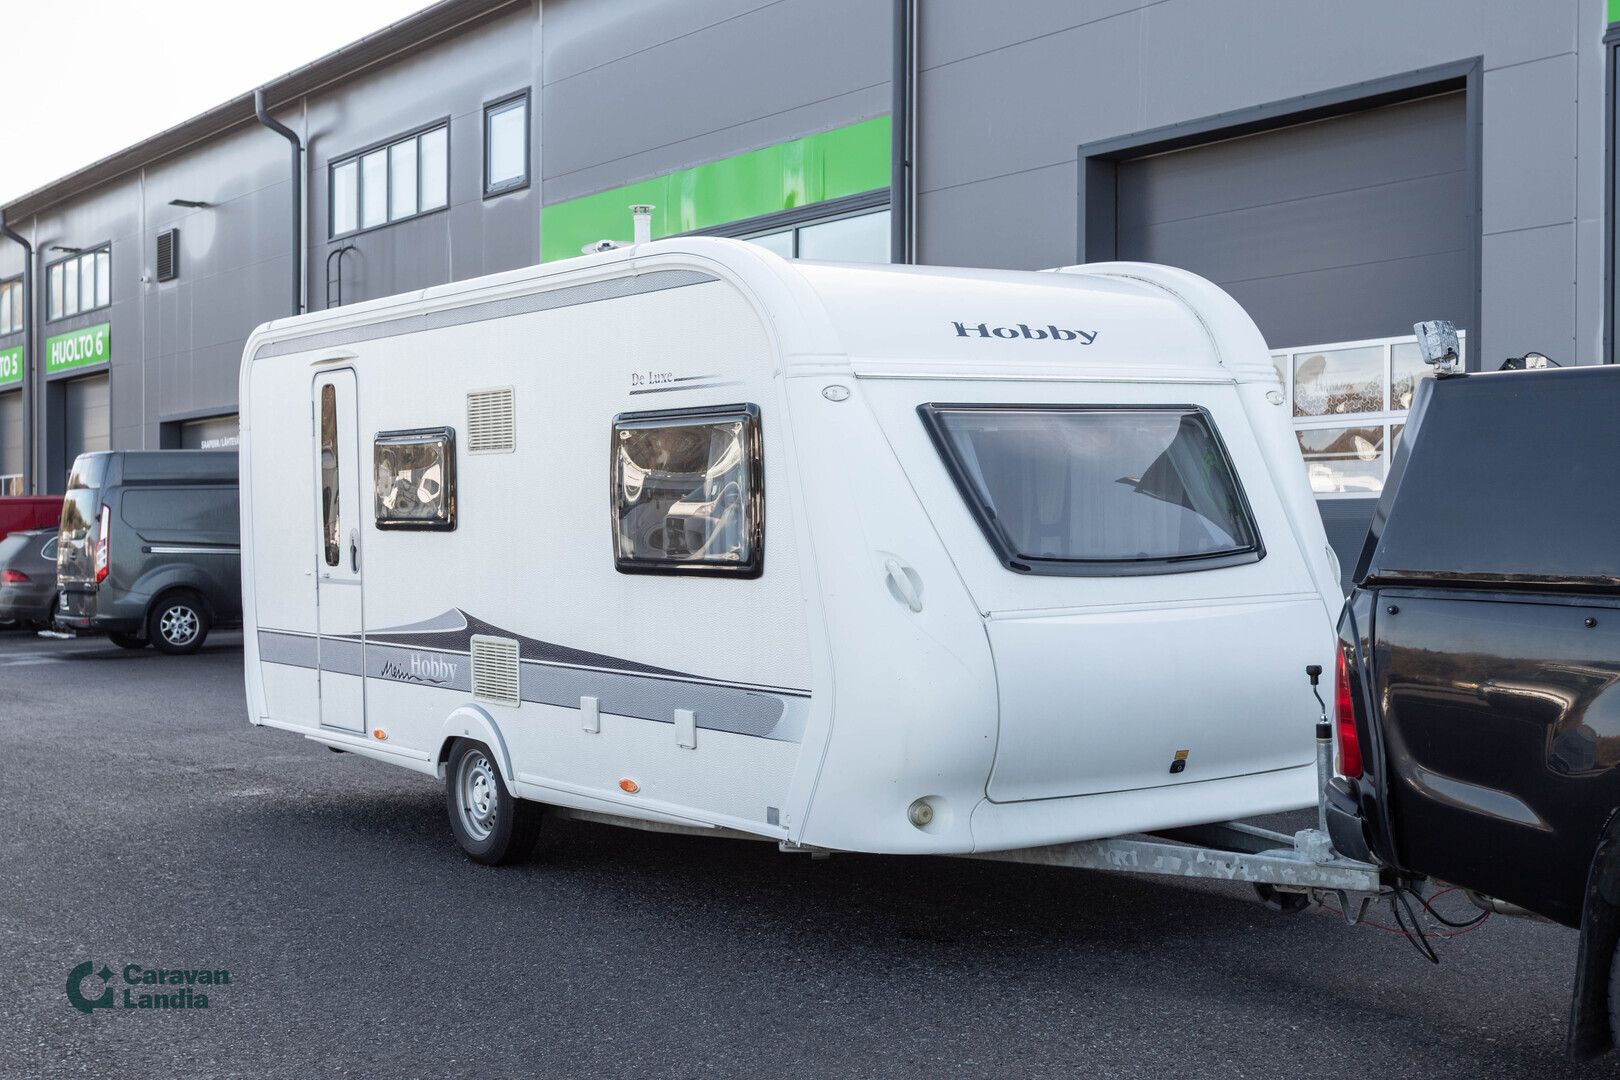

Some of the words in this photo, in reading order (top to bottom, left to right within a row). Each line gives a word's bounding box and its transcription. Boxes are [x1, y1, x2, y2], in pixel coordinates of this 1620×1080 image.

[951, 321, 1098, 345] Hobby
[51, 335, 93, 365] HUOLTO
[95, 331, 104, 355] 6
[12, 352, 18, 375] 5
[632, 372, 645, 386] De
[648, 371, 673, 384] Luxe
[381, 659, 422, 681] Mein
[411, 653, 457, 684] Hobby
